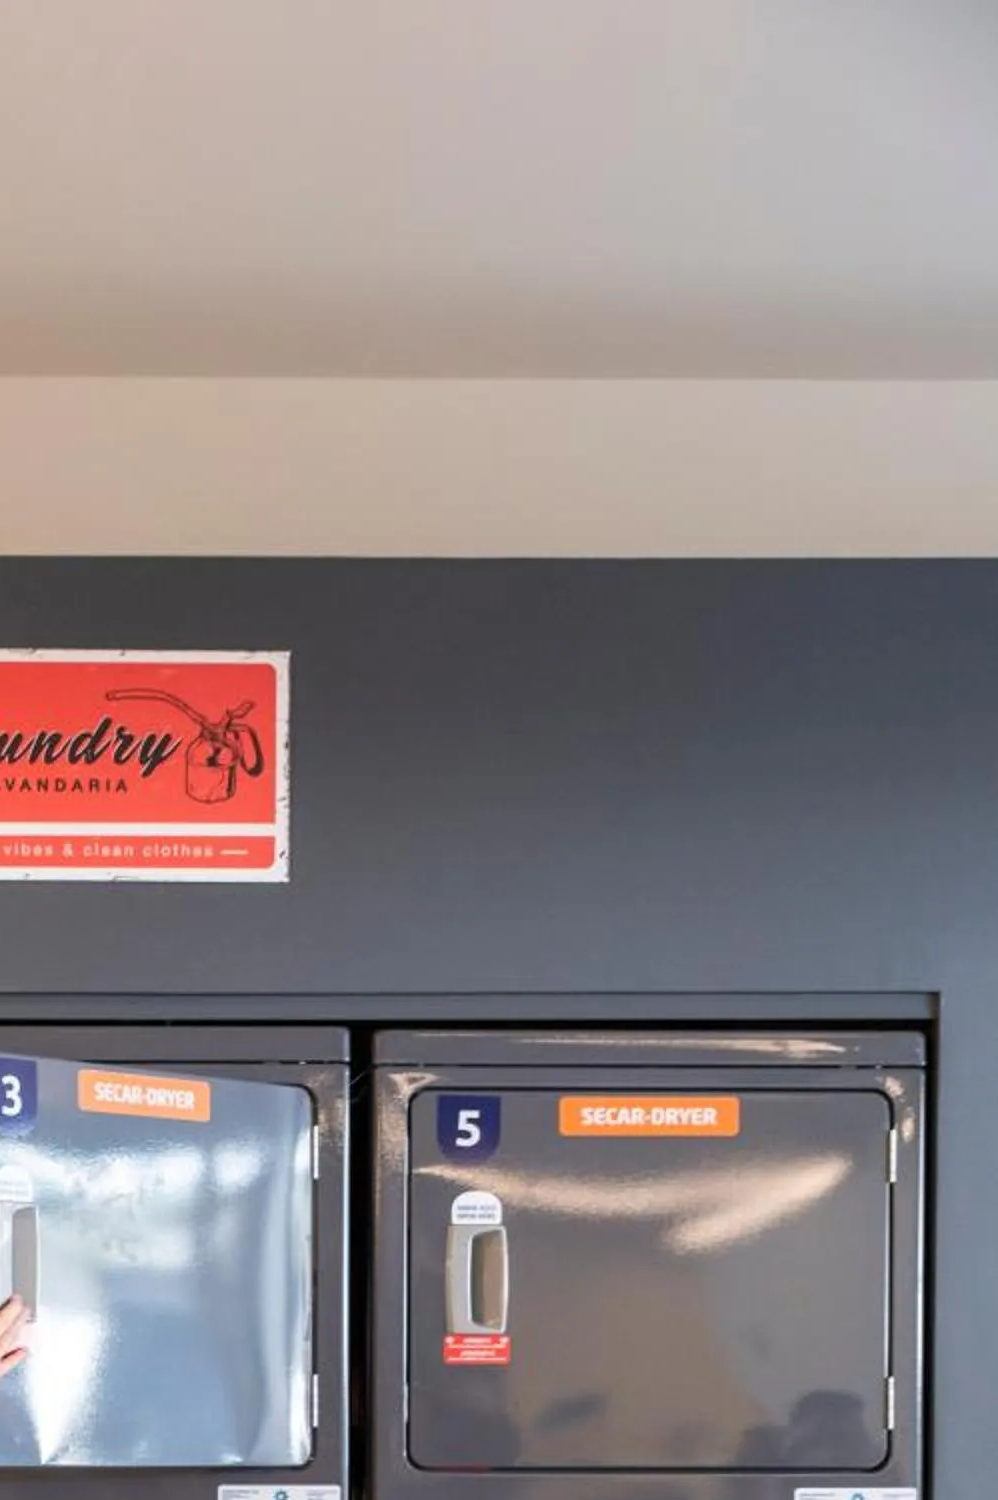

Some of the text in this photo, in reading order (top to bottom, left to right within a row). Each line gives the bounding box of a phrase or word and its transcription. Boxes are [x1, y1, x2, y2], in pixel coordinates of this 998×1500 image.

[3, 841, 54, 857] vibes
[61, 842, 74, 857] &
[83, 842, 135, 858] clean
[141, 842, 214, 858] clothes
[1, 1074, 23, 1116] 3
[93, 1081, 195, 1110] SECAR-DRYER
[455, 1110, 481, 1147] 5
[580, 1106, 717, 1126] SECAR-DRYER
